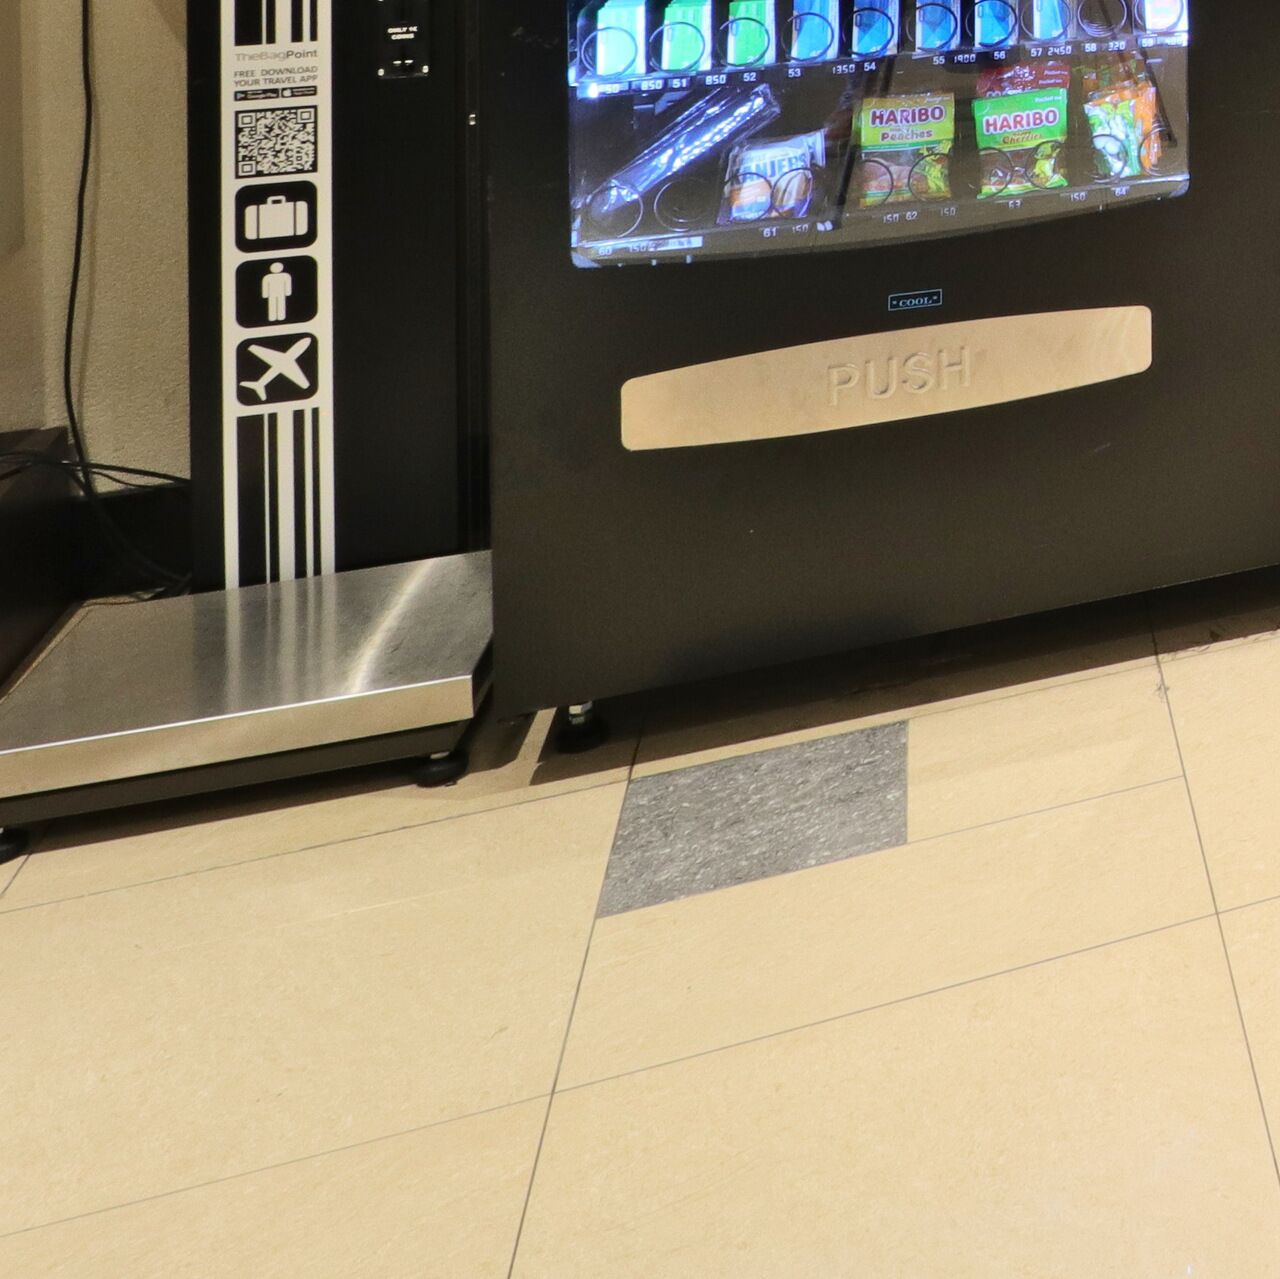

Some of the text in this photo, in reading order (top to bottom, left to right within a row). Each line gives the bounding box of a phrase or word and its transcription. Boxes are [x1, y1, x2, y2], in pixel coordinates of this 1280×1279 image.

[1031, 47, 1043, 57] 57
[1085, 42, 1097, 52] 58
[234, 48, 318, 62] TheBagPoint
[932, 55, 945, 65] 55
[993, 50, 1006, 60] 56
[863, 61, 876, 71] 54
[234, 65, 318, 78] FREE DOWNLOAD
[788, 67, 801, 78] 53
[234, 74, 318, 87] YOUR TRAVEL APP
[743, 72, 757, 82] 52
[672, 78, 687, 88] 51
[871, 105, 945, 127] HARIBO
[984, 109, 1058, 134] HARIBO
[881, 130, 933, 142] Peaches
[763, 227, 777, 237] 61
[827, 345, 971, 407] PUSH
